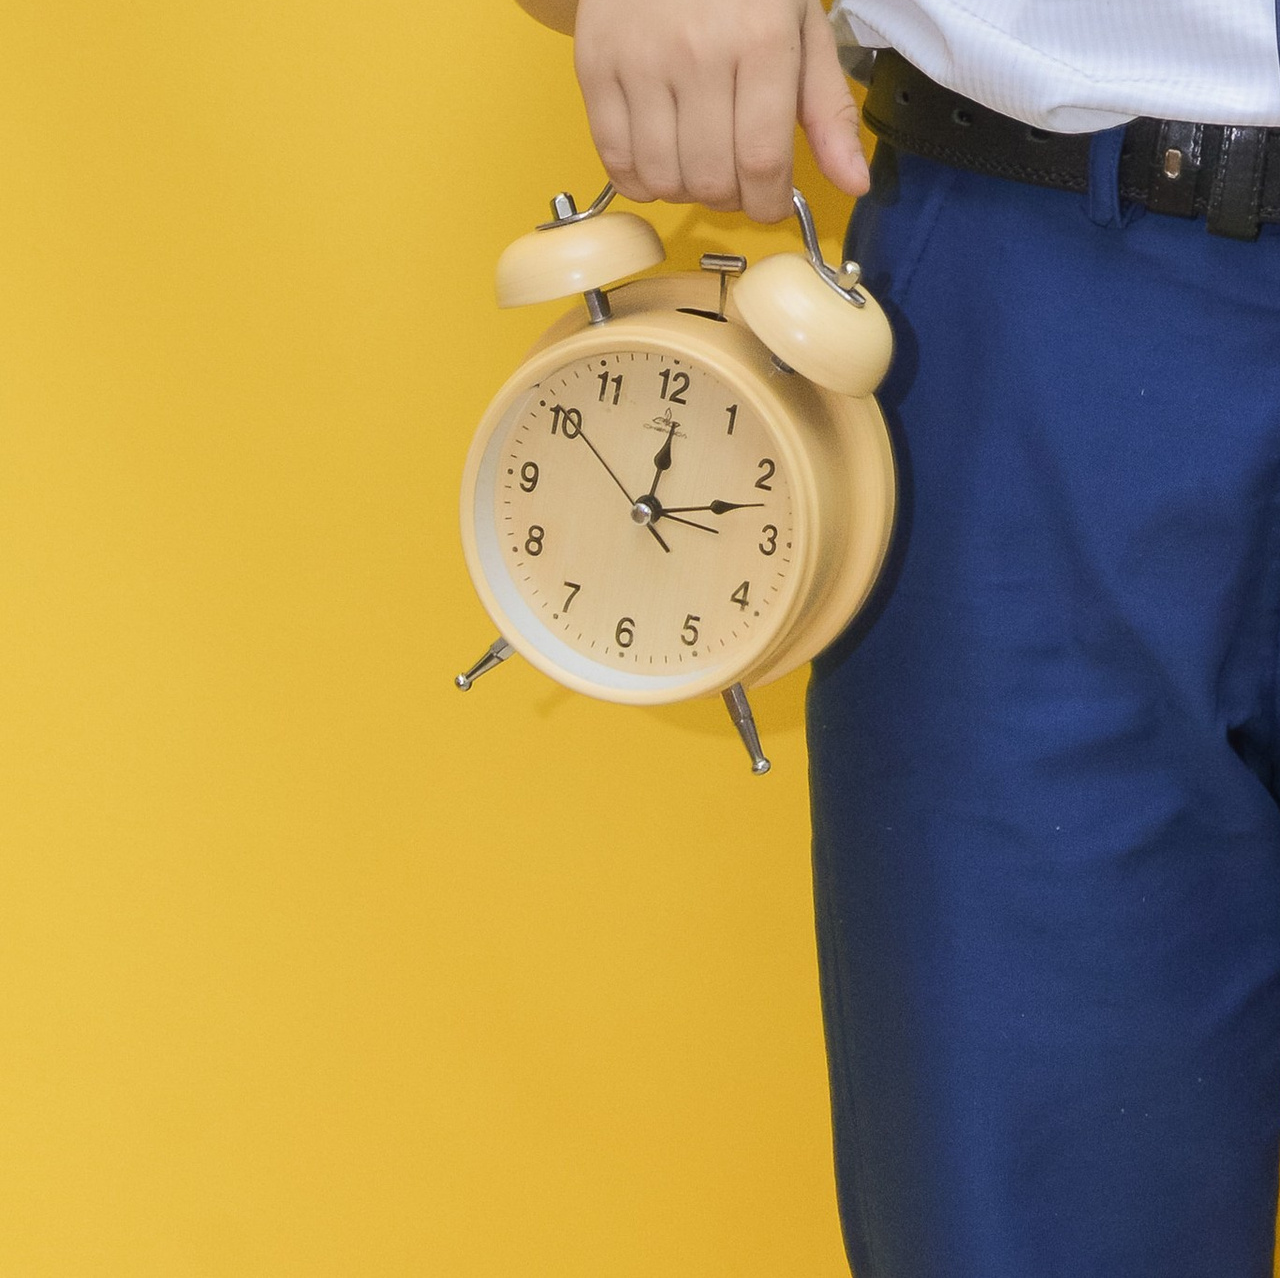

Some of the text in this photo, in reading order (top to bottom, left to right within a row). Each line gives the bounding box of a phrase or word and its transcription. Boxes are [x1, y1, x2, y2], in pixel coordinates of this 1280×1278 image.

[597, 370, 624, 405] 11
[658, 368, 690, 405] 12
[550, 404, 582, 439] 10
[726, 404, 738, 435] 1
[520, 461, 539, 492] 9
[755, 458, 775, 491] 2
[525, 525, 544, 556] 8
[759, 524, 778, 555] 3
[563, 581, 581, 613] 7
[730, 581, 750, 611] 4
[615, 617, 635, 648] 6
[681, 614, 700, 646] 5
